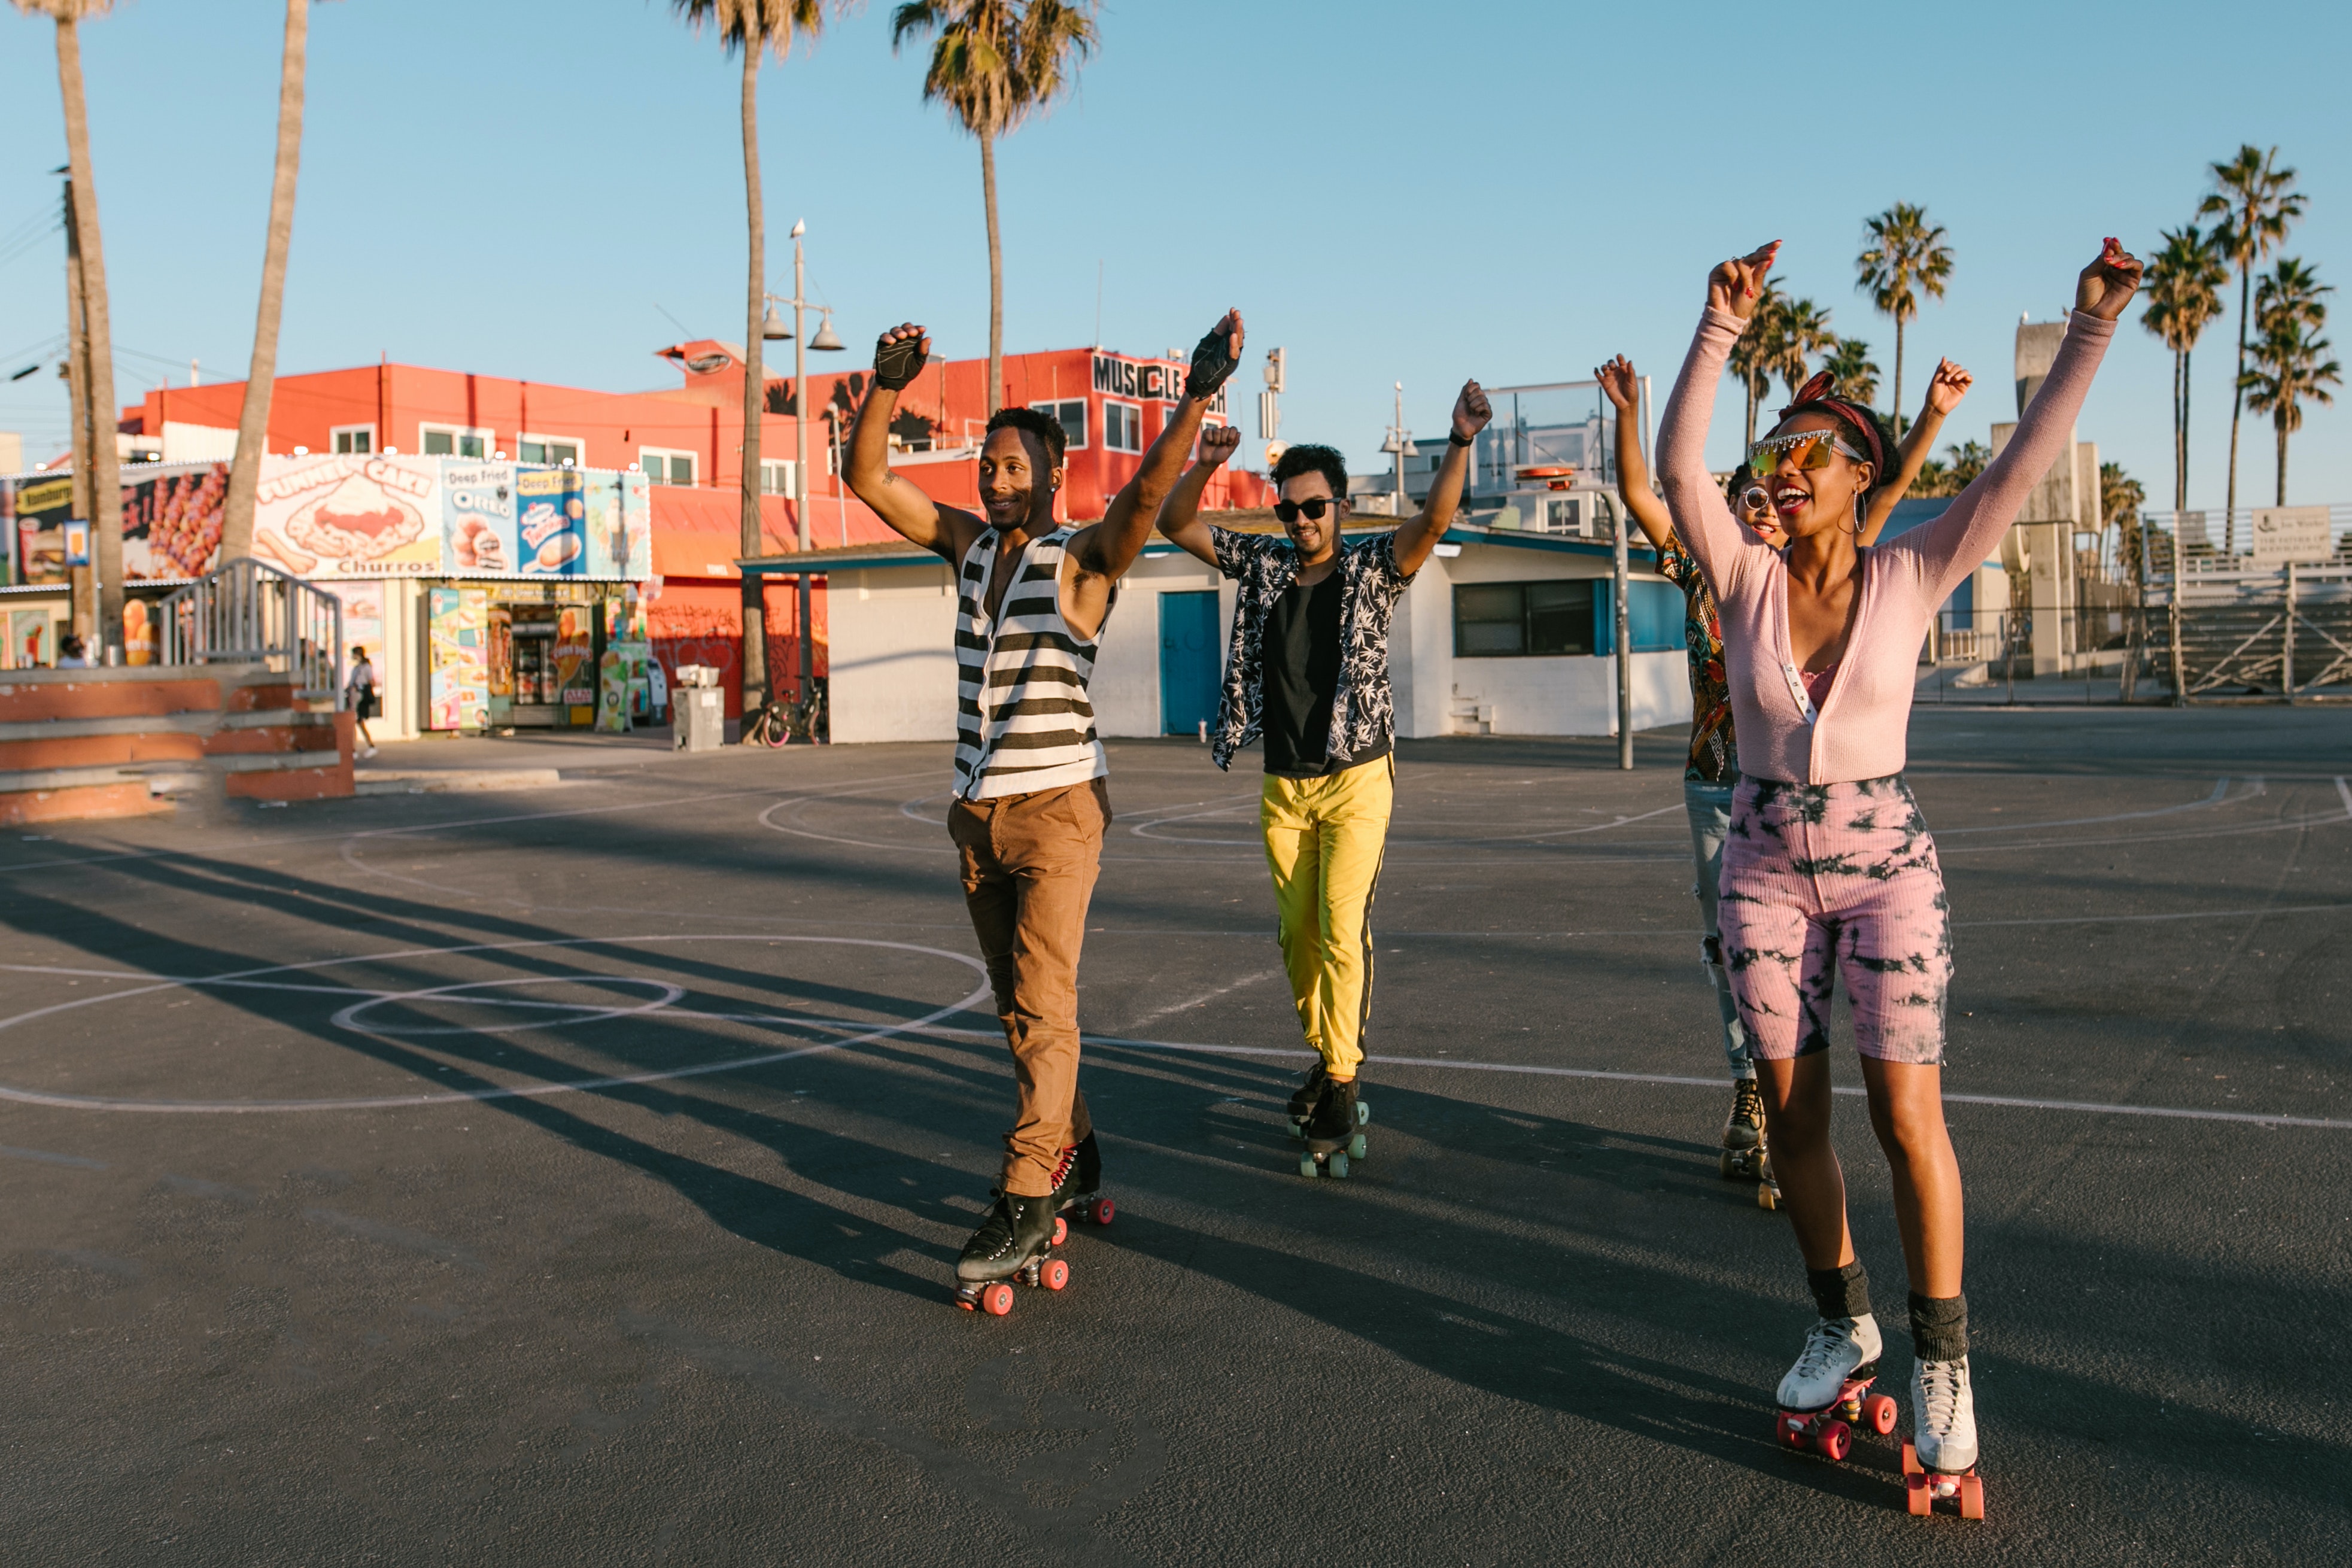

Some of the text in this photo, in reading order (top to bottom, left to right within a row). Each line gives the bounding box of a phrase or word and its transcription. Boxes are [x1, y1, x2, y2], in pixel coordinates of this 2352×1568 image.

[1094, 355, 1181, 400] MUSCLE
[256, 460, 431, 504] FUNNEL CAKE
[449, 470, 508, 484] Deep Fried
[523, 478, 549, 489] Deep
[453, 490, 510, 519] OREO
[338, 560, 436, 573] Churros
